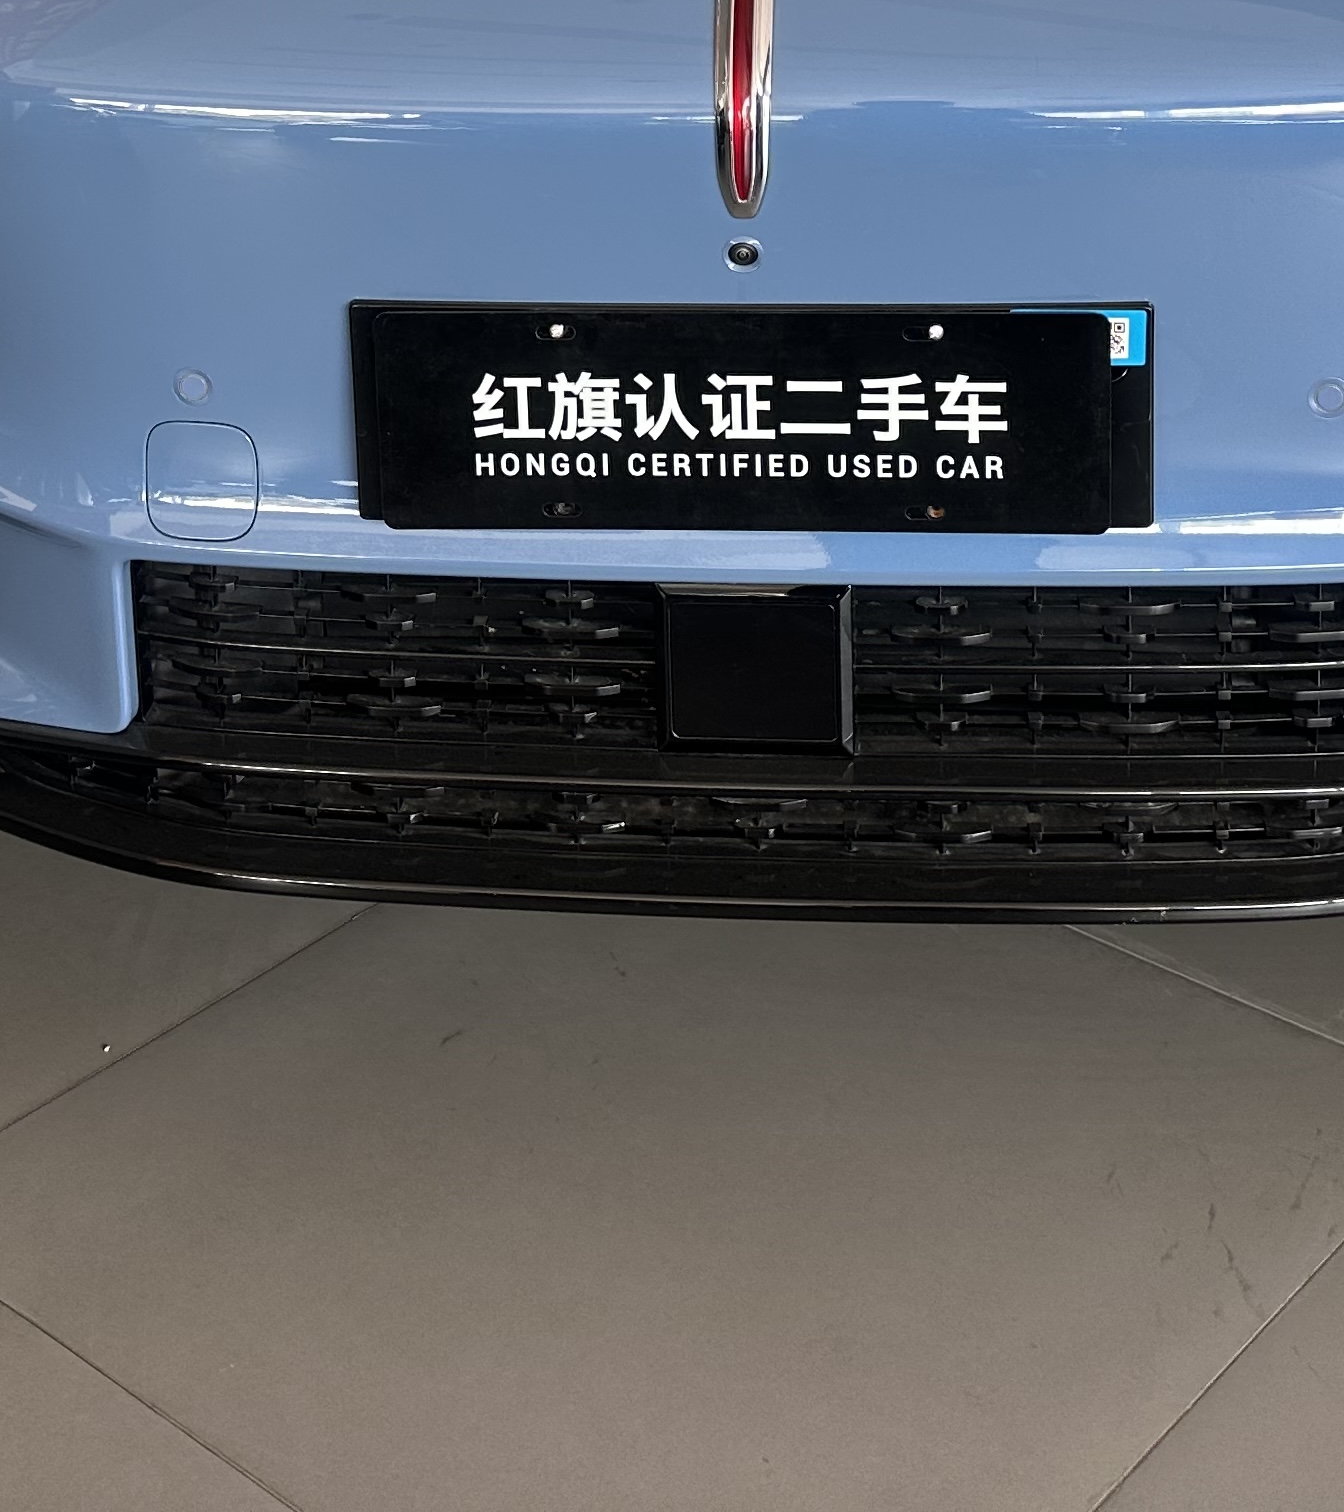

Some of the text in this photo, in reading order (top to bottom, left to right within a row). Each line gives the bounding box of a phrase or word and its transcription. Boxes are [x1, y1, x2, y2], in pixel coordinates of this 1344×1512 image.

[471, 371, 1008, 444] 红旗认证二手车
[474, 451, 1004, 479] HONGQI CERTIFIED USED CAR
